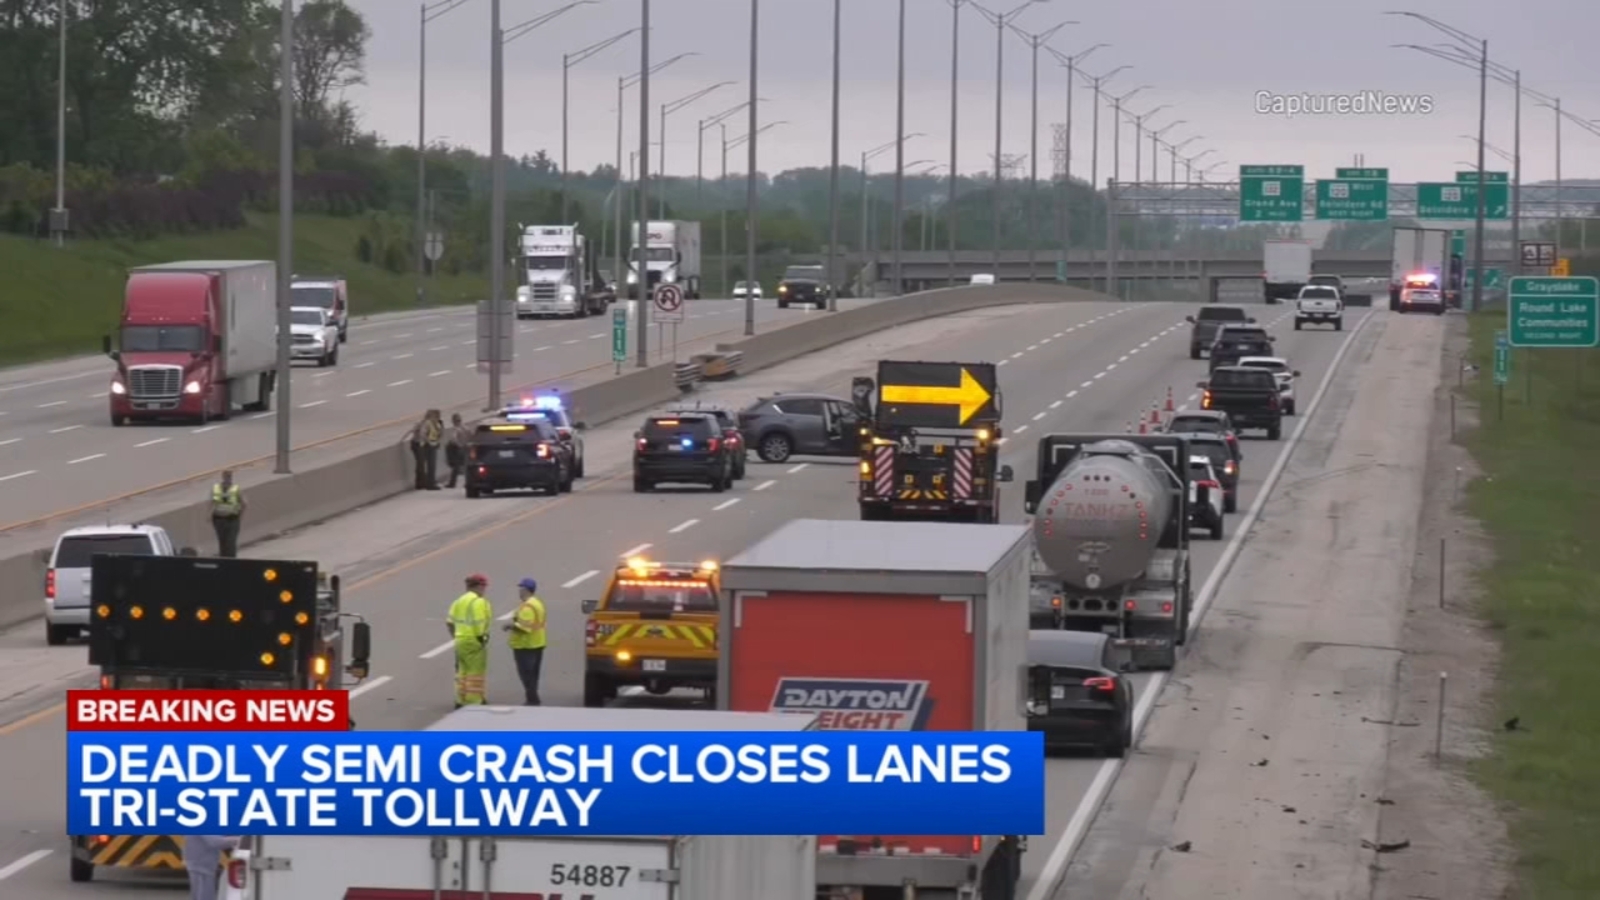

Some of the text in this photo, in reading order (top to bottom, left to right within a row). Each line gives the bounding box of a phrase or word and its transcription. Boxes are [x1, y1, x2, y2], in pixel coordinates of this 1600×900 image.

[1519, 302, 1587, 312] Round Lake
[1518, 318, 1588, 327] Communities
[784, 689, 910, 709] DAYTON
[817, 711, 905, 729] EIGHT
[550, 864, 631, 887] 54887
